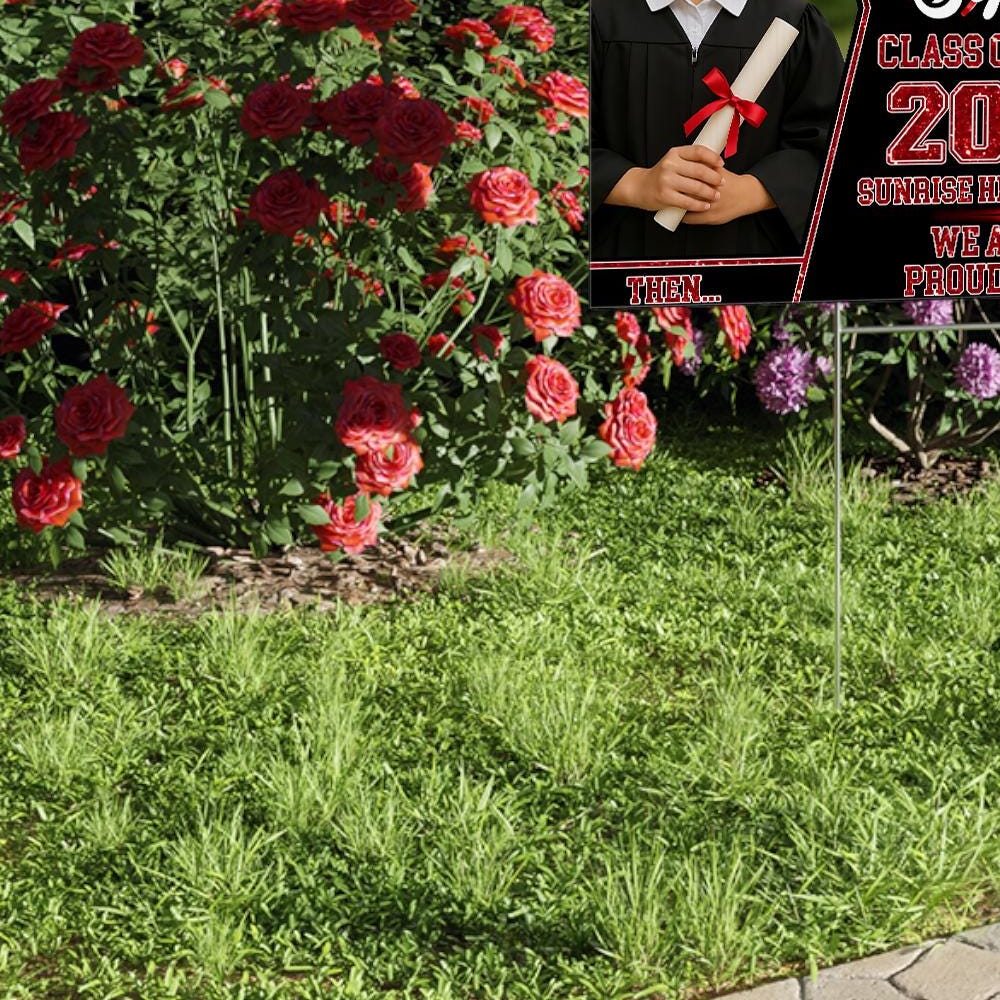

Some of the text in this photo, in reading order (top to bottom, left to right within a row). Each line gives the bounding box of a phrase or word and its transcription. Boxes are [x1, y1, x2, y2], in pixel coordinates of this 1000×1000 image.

[877, 33, 983, 69] CLASS
[857, 176, 973, 206] SUNRISE
[930, 225, 980, 258] WE
[626, 275, 722, 305] THEN...
